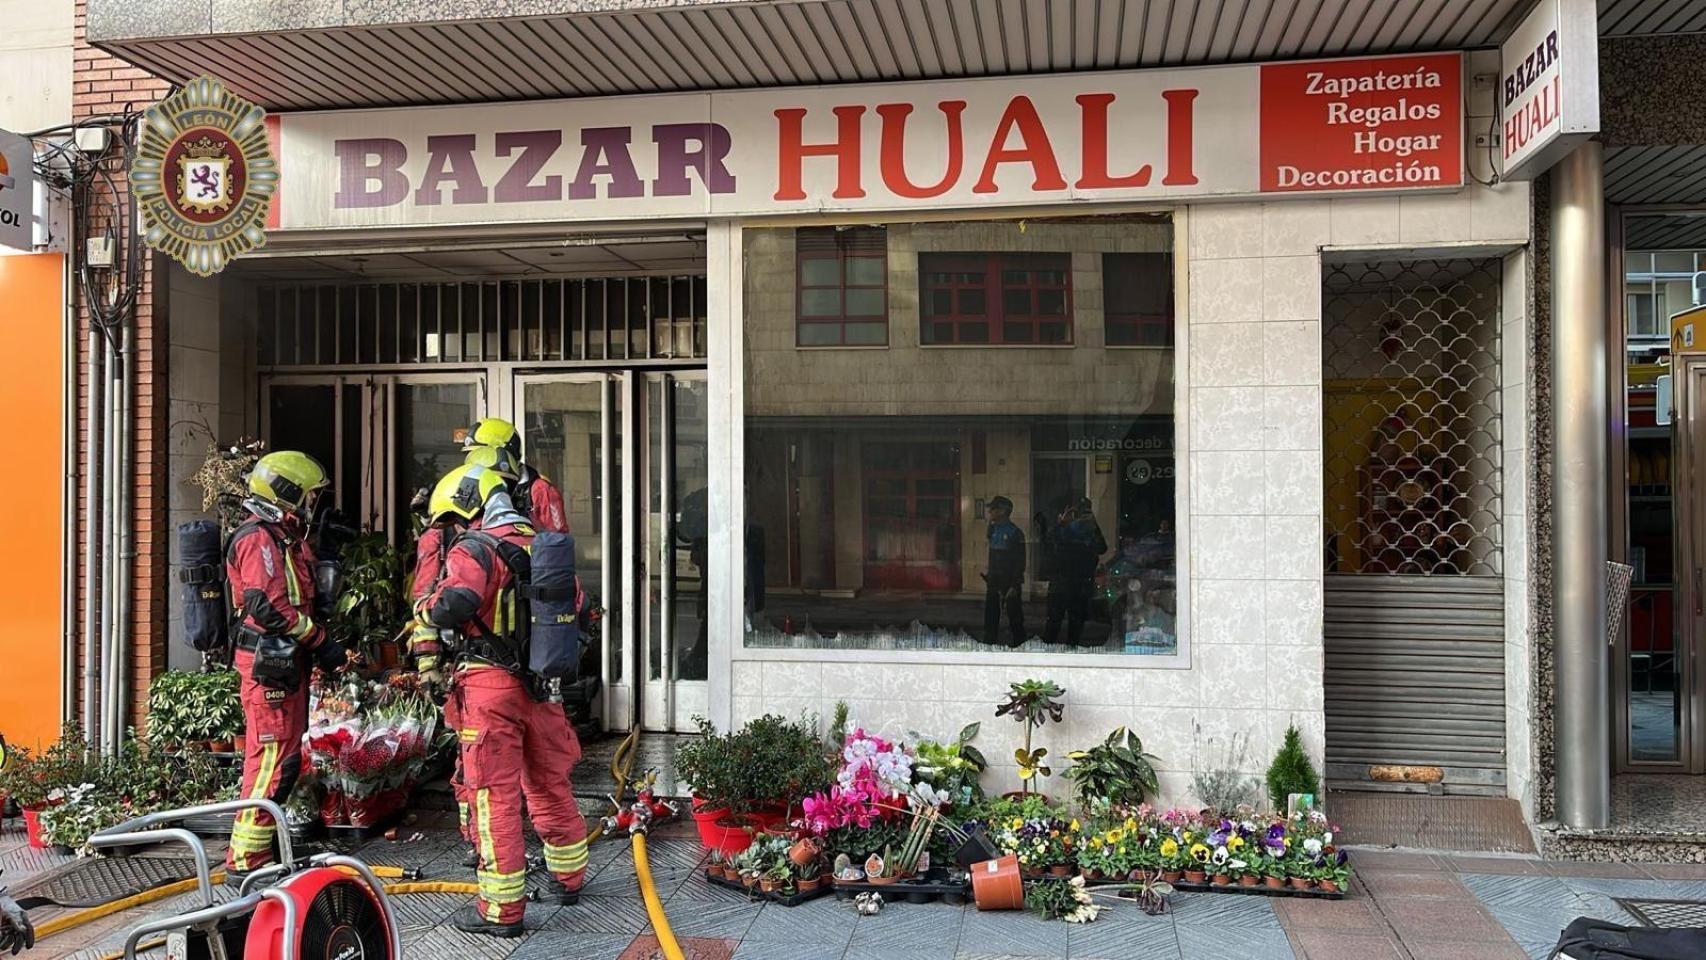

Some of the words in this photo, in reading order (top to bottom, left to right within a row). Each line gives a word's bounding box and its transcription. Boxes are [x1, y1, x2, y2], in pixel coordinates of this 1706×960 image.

[1306, 66, 1441, 97] Zapatería
[1505, 30, 1559, 108] BAZAR
[1327, 98, 1441, 127] Regalos
[1504, 74, 1560, 160] HUALI
[334, 122, 737, 210] BAZAR
[773, 89, 1199, 201] HUALI
[1354, 131, 1441, 156] Hogar
[1277, 160, 1441, 187] Decoración
[0, 208, 21, 228] OL
